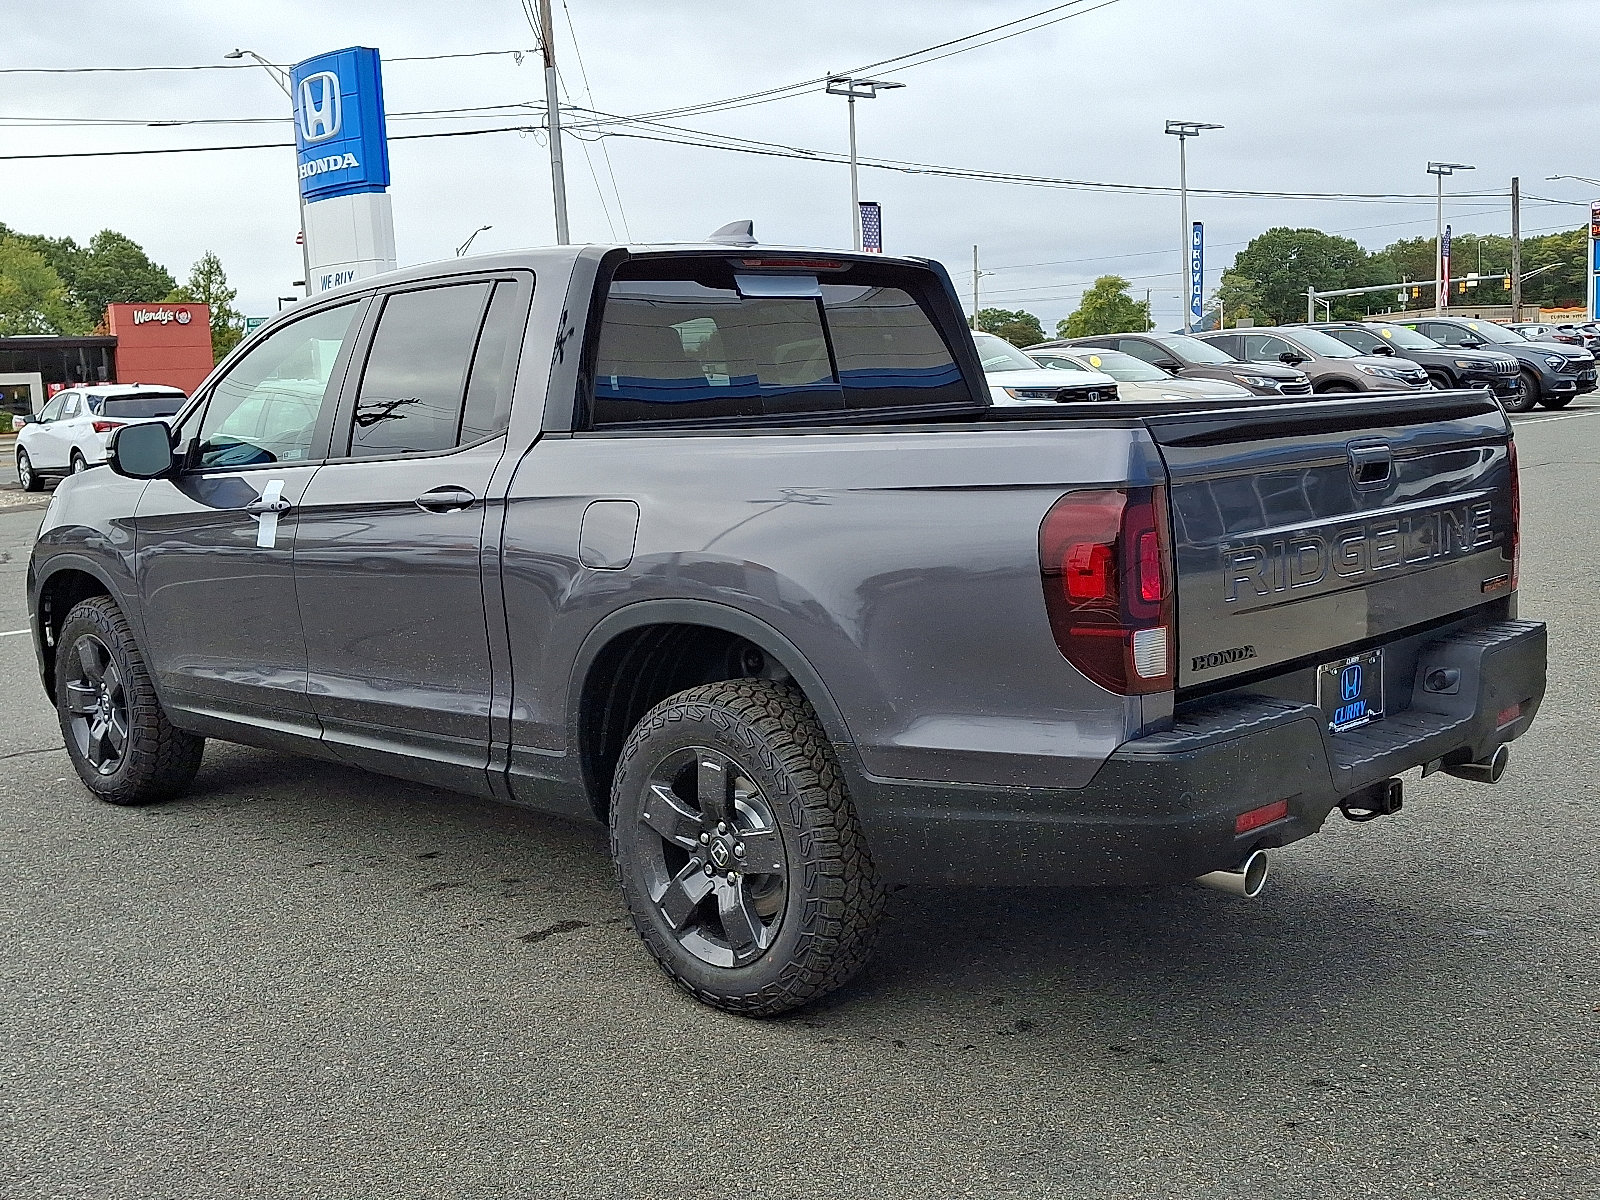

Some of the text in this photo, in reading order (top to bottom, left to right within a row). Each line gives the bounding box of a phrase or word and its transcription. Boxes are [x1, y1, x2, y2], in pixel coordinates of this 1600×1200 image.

[299, 152, 360, 180] HONDA
[320, 274, 332, 291] WE
[133, 307, 174, 325] Wendy's
[1223, 501, 1493, 602] RIDGELINE
[1191, 644, 1258, 672] HONDA
[1334, 699, 1367, 725] CURRY
